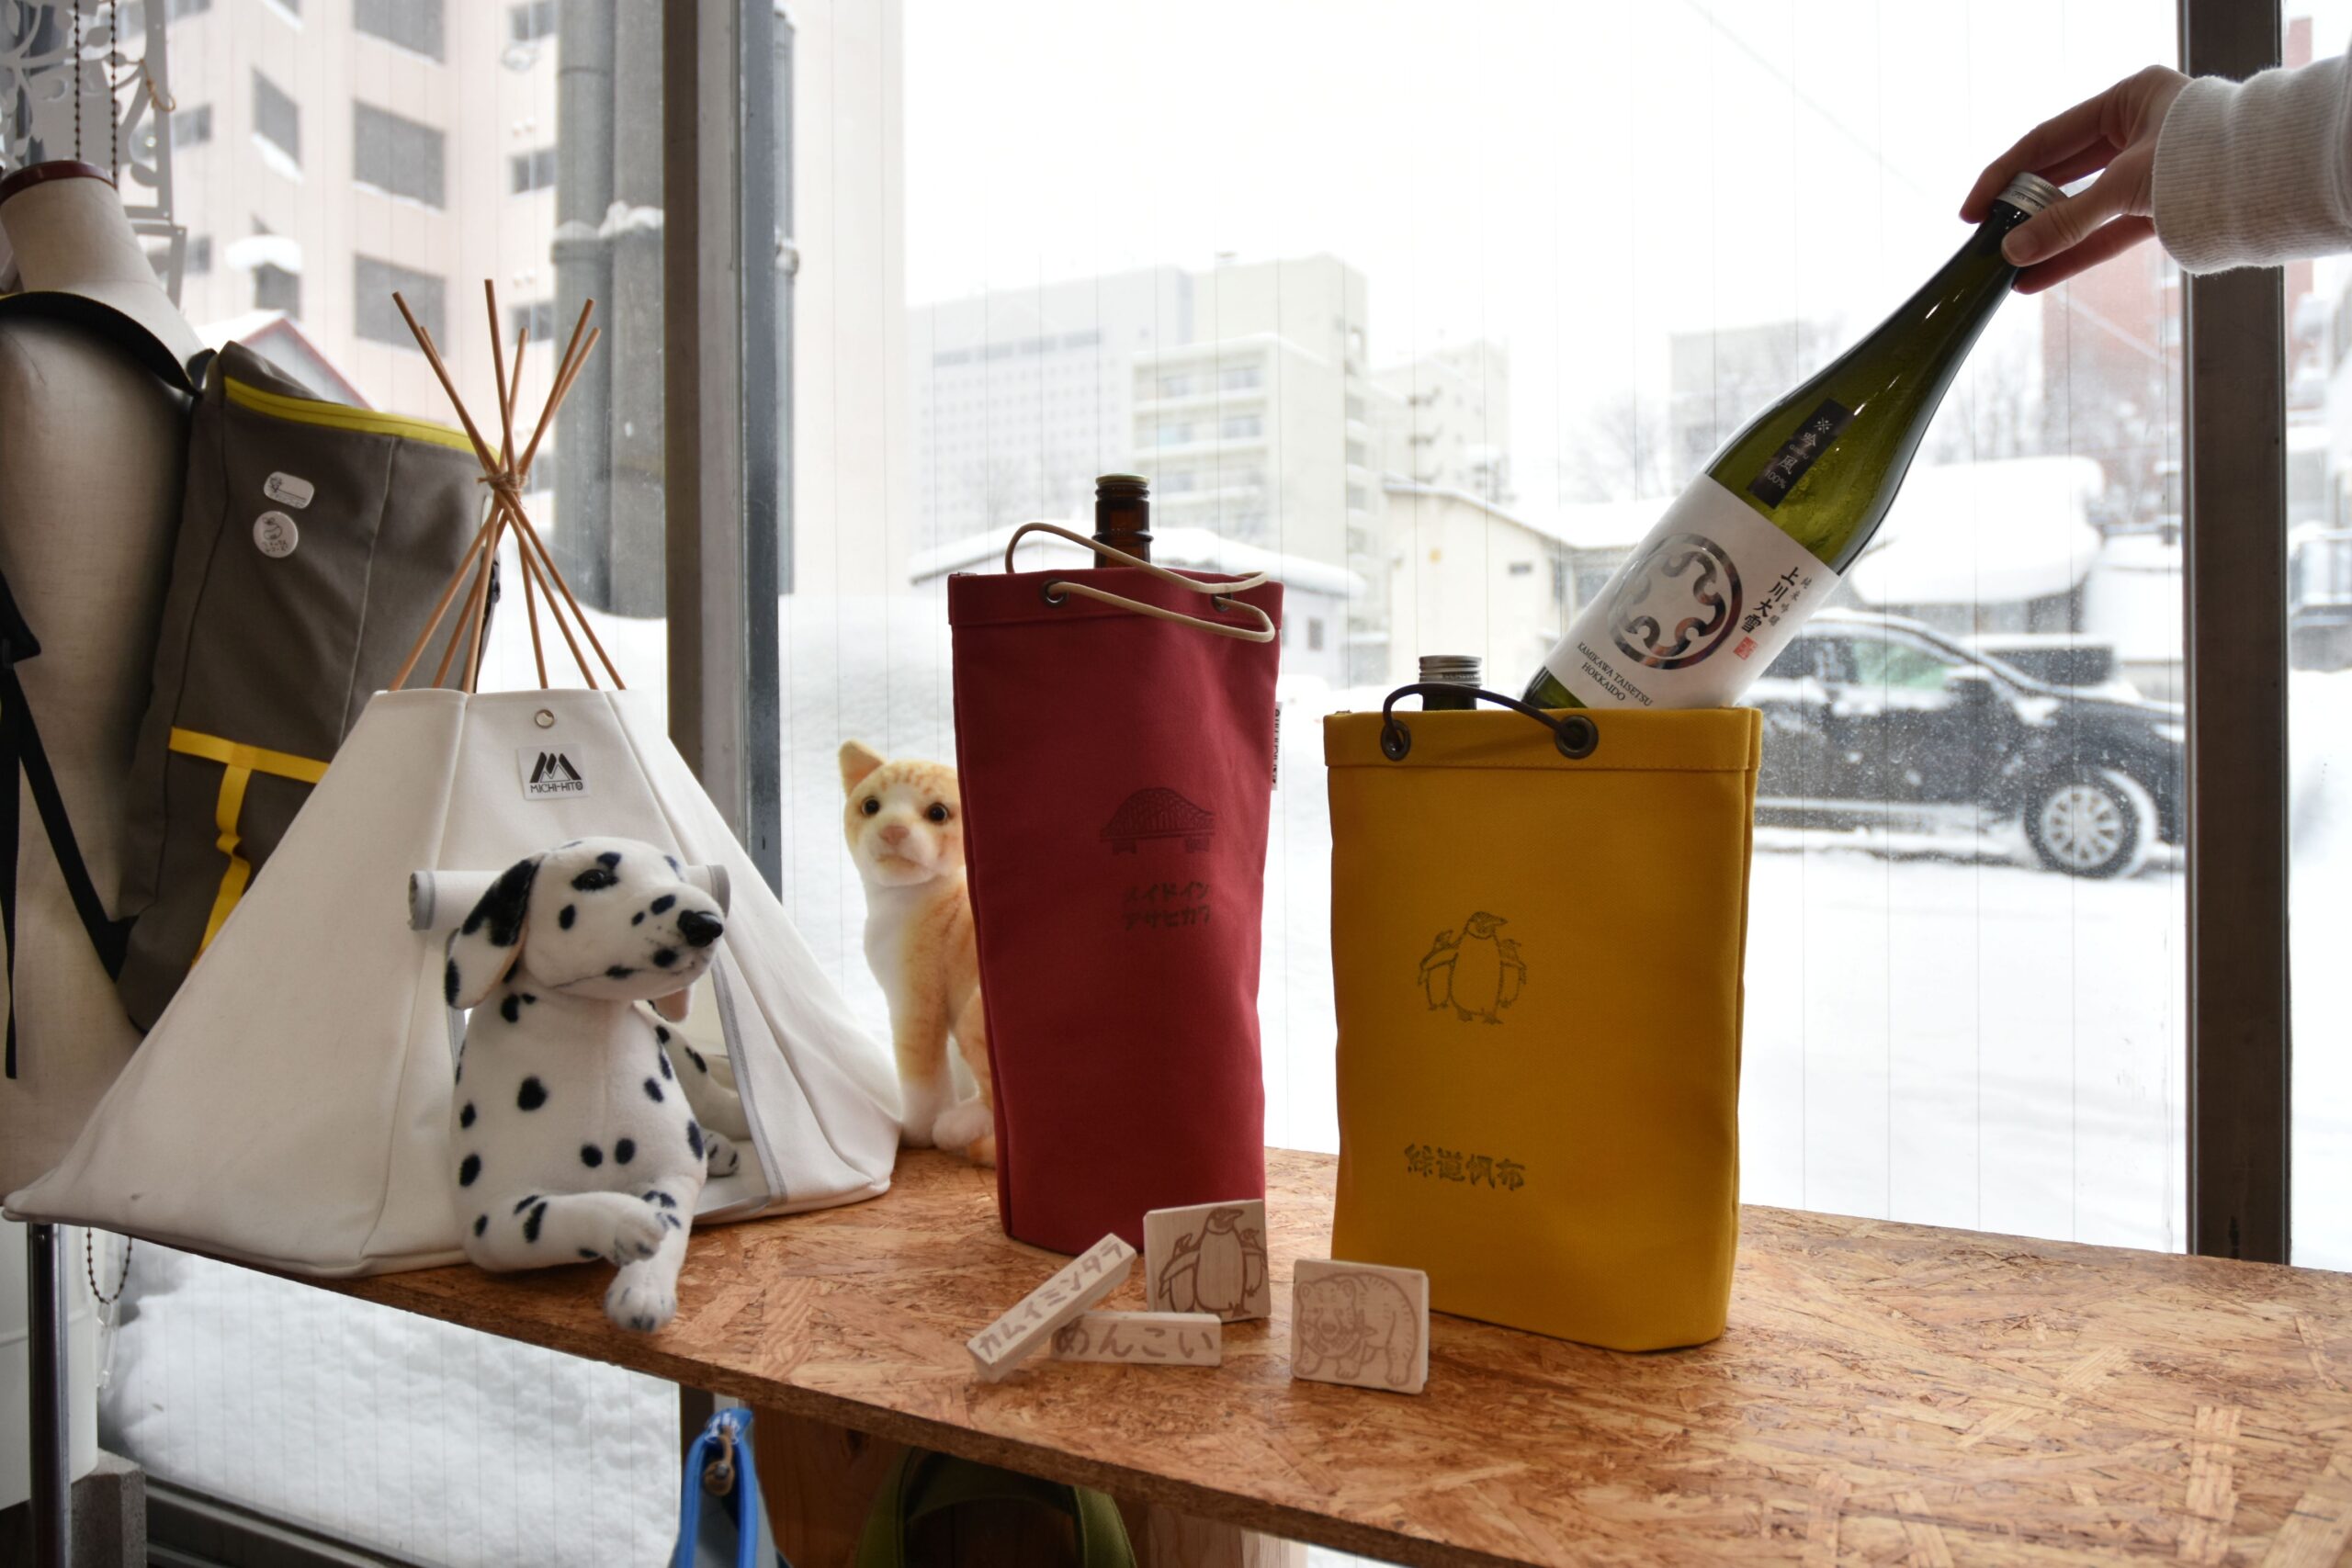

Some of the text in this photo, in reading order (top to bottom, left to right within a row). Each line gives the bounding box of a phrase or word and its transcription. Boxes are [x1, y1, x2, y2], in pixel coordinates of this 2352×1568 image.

[1764, 469, 1788, 490] 100%
[1741, 566, 1800, 634] 上川大雪
[1577, 641, 1655, 706] KAMIKAWA TAISETSU
[1581, 661, 1626, 701] HOKKAIDO
[977, 1239, 1125, 1358] カムイミンタラ
[1055, 1322, 1215, 1359] めんこい
